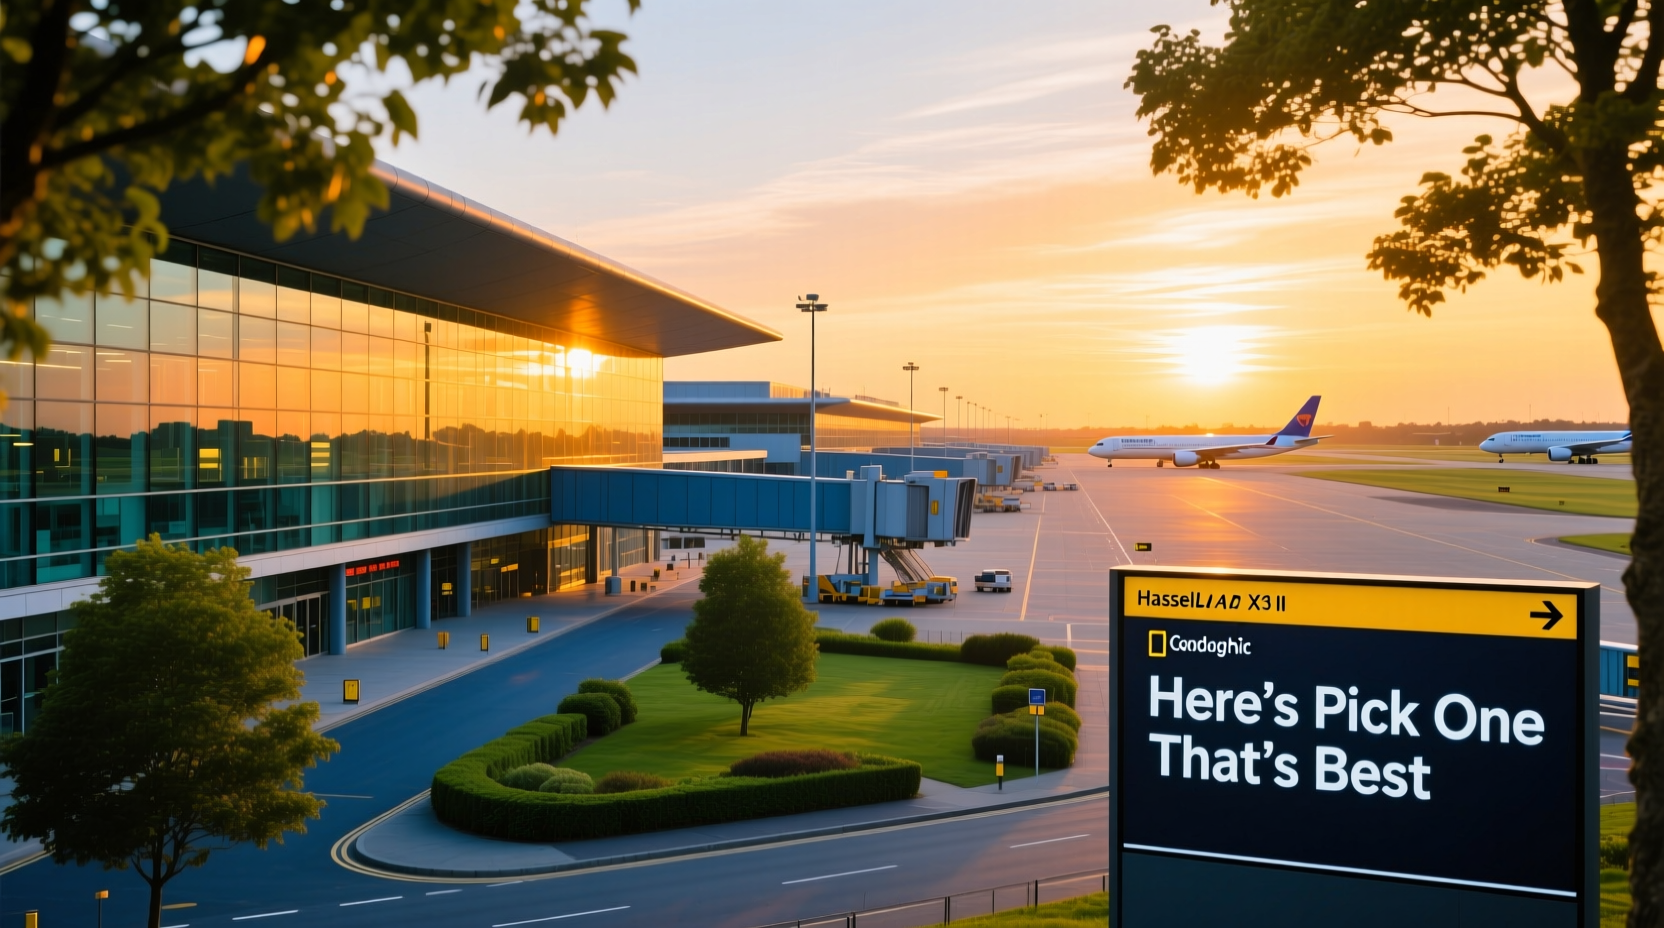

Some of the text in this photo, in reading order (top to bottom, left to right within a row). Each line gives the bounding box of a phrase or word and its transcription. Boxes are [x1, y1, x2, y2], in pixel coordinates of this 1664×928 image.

[1248, 594, 1271, 611] X3
[1149, 675, 1545, 746] Here’s Pick One
[1149, 733, 1431, 800] That’s Best
